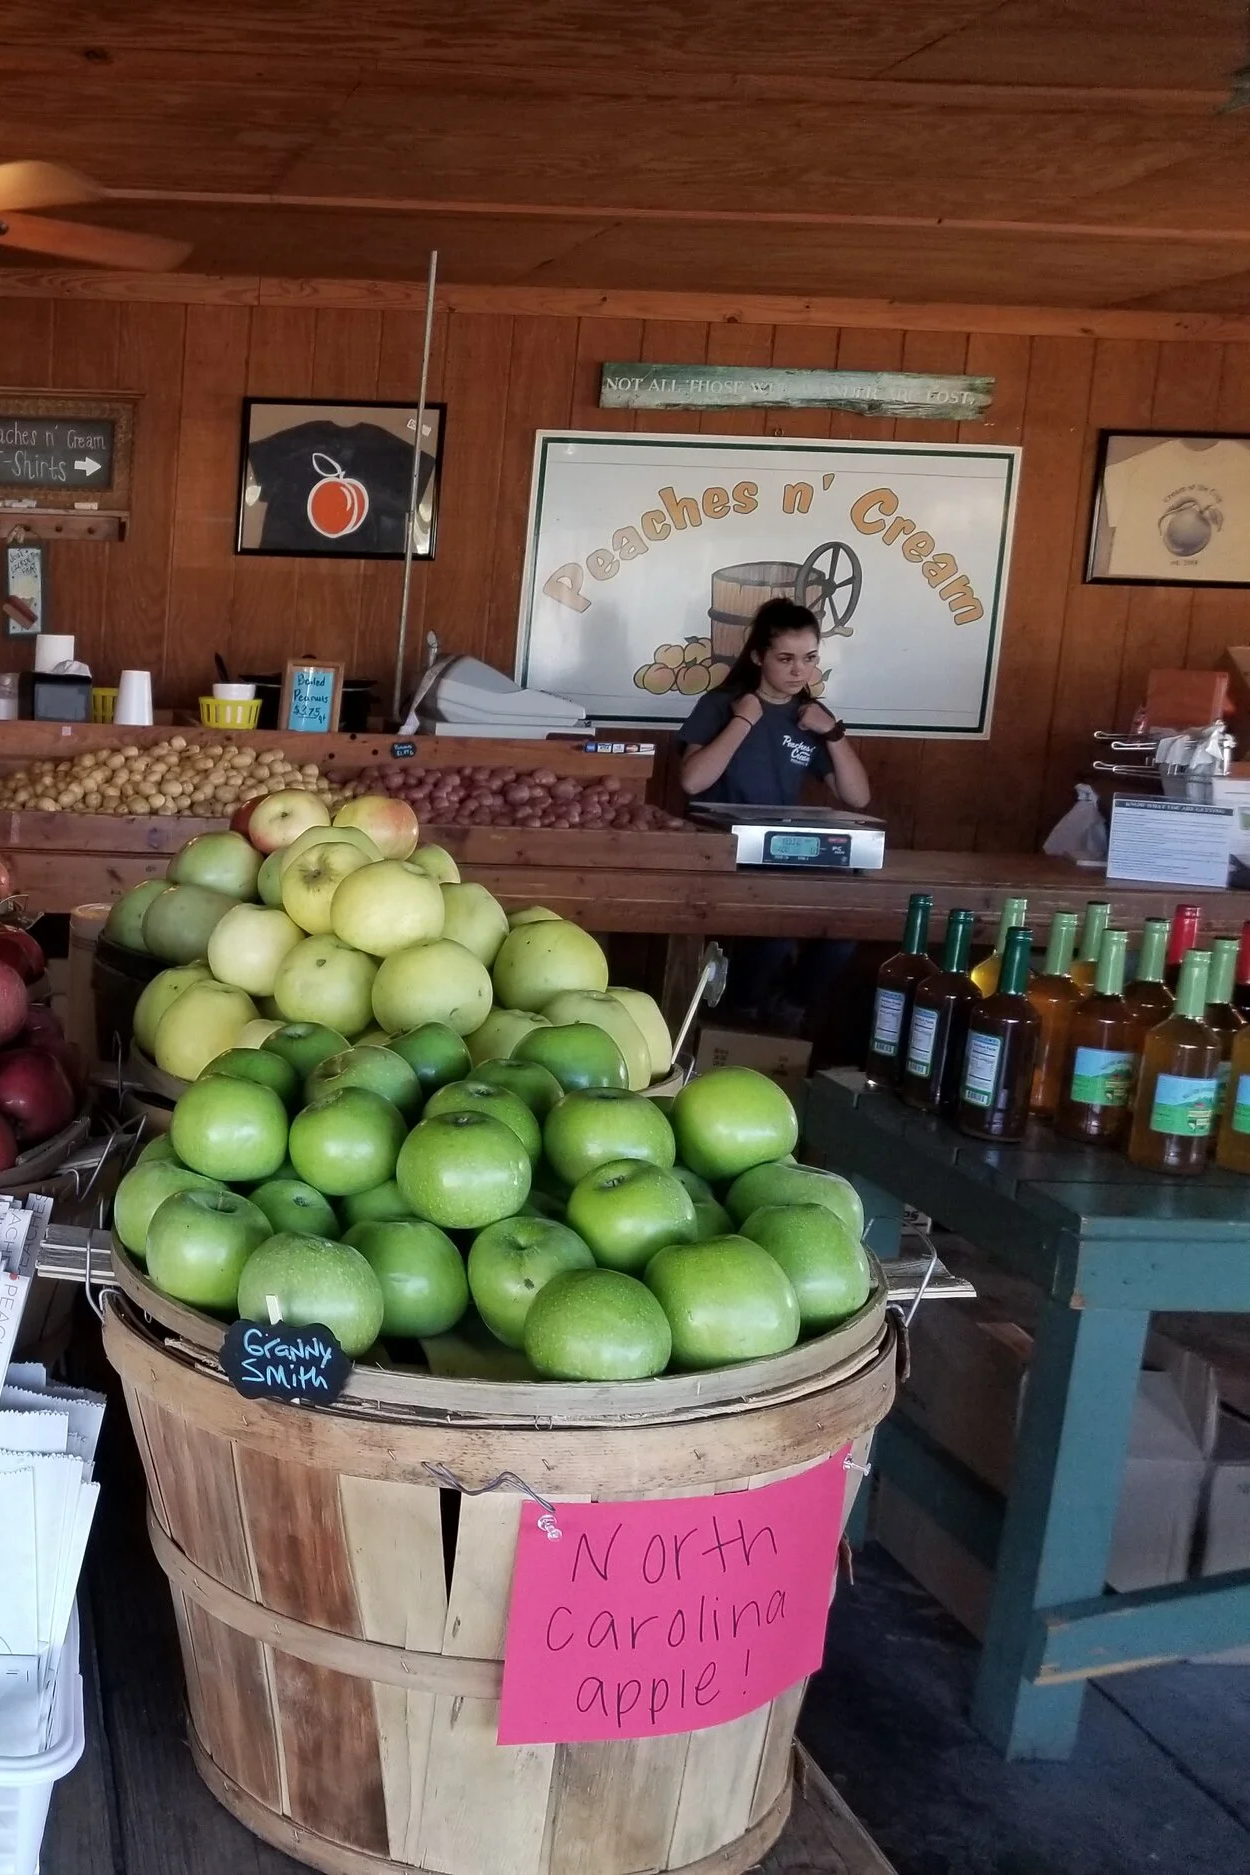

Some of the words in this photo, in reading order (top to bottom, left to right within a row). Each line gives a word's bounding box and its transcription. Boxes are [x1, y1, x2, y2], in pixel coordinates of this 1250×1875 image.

[606, 377, 643, 391] NOT
[650, 378, 683, 393] ALL
[67, 429, 107, 450] Cream
[542, 481, 758, 614] Peaches
[781, 473, 835, 515] n'
[850, 488, 985, 626] Cream
[571, 1515, 778, 1585] North
